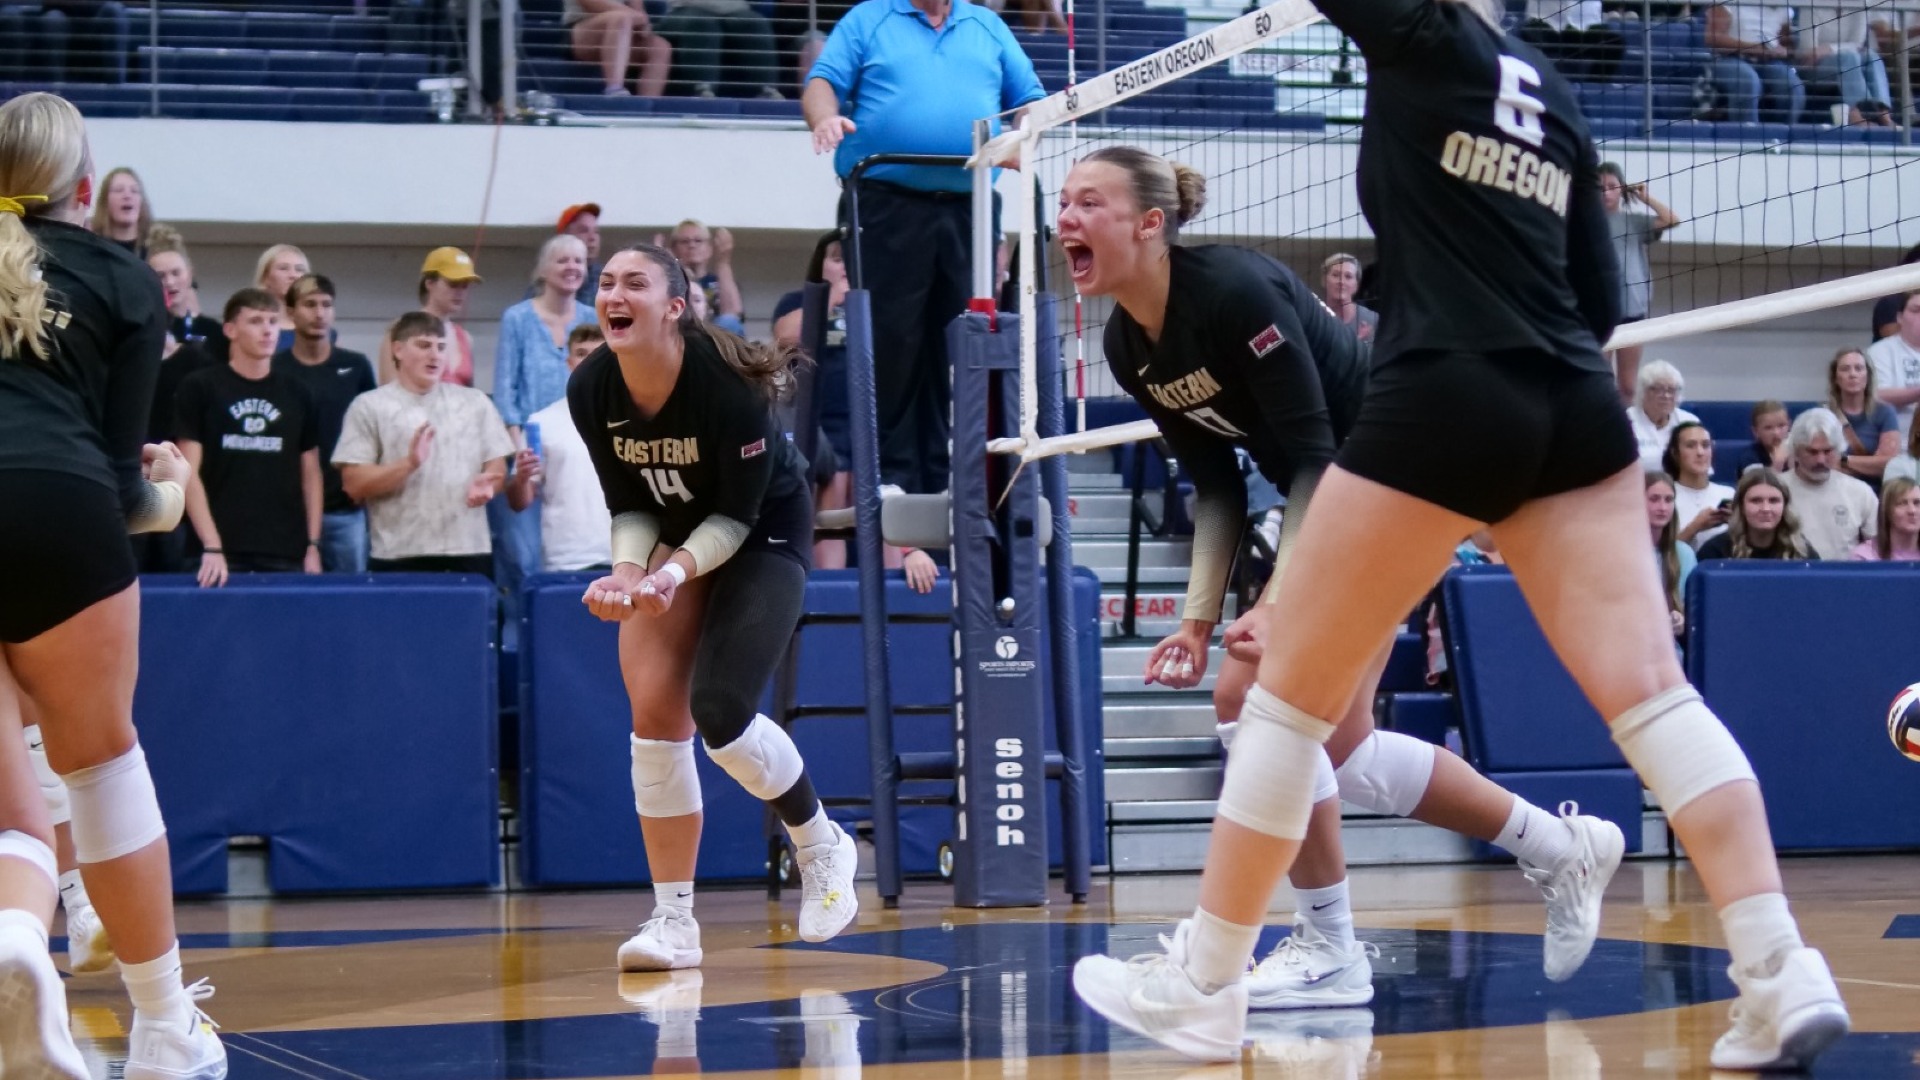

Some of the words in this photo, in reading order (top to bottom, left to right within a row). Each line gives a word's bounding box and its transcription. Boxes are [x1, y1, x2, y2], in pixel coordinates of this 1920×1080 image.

[1114, 64, 1165, 95] EASTERN
[1164, 34, 1217, 73] OREGON
[1493, 54, 1546, 148] 6
[1440, 131, 1572, 217] OREGON
[1147, 366, 1222, 409] EASTERN
[229, 398, 281, 421] EASTERN
[1184, 406, 1248, 437] 17
[613, 436, 699, 465] EASTERN
[640, 468, 694, 507] 14
[1107, 598, 1176, 617] CEAR
[995, 737, 1025, 846] senoh
